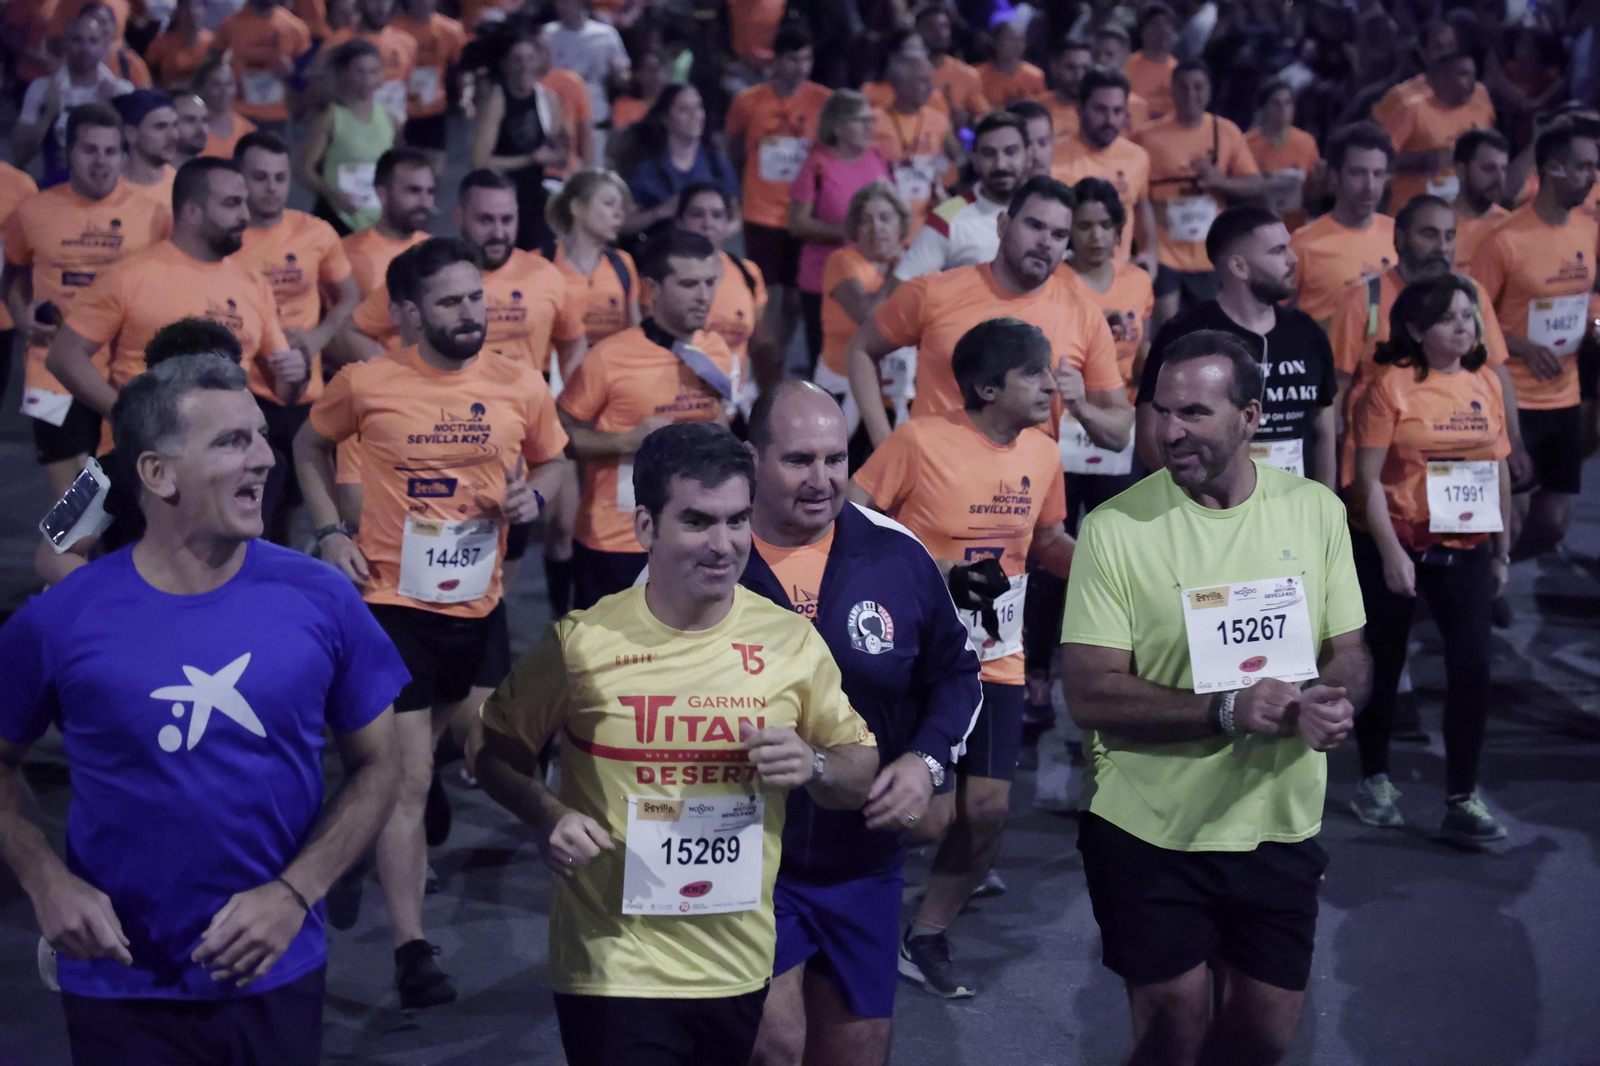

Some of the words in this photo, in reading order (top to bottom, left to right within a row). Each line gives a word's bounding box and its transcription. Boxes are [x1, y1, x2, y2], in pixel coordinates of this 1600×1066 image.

[1279, 360, 1306, 375] ON
[434, 424, 491, 432] NOCTURNA
[407, 435, 458, 444] SEVILLA
[1444, 485, 1484, 501] 17991
[969, 505, 1012, 514] SEVILLA
[426, 548, 481, 567] 14487
[848, 604, 862, 627] MANO
[1217, 614, 1287, 645] 15267
[688, 696, 767, 708] GARMIN
[636, 765, 758, 785] DESERT
[661, 836, 741, 865] 15269
